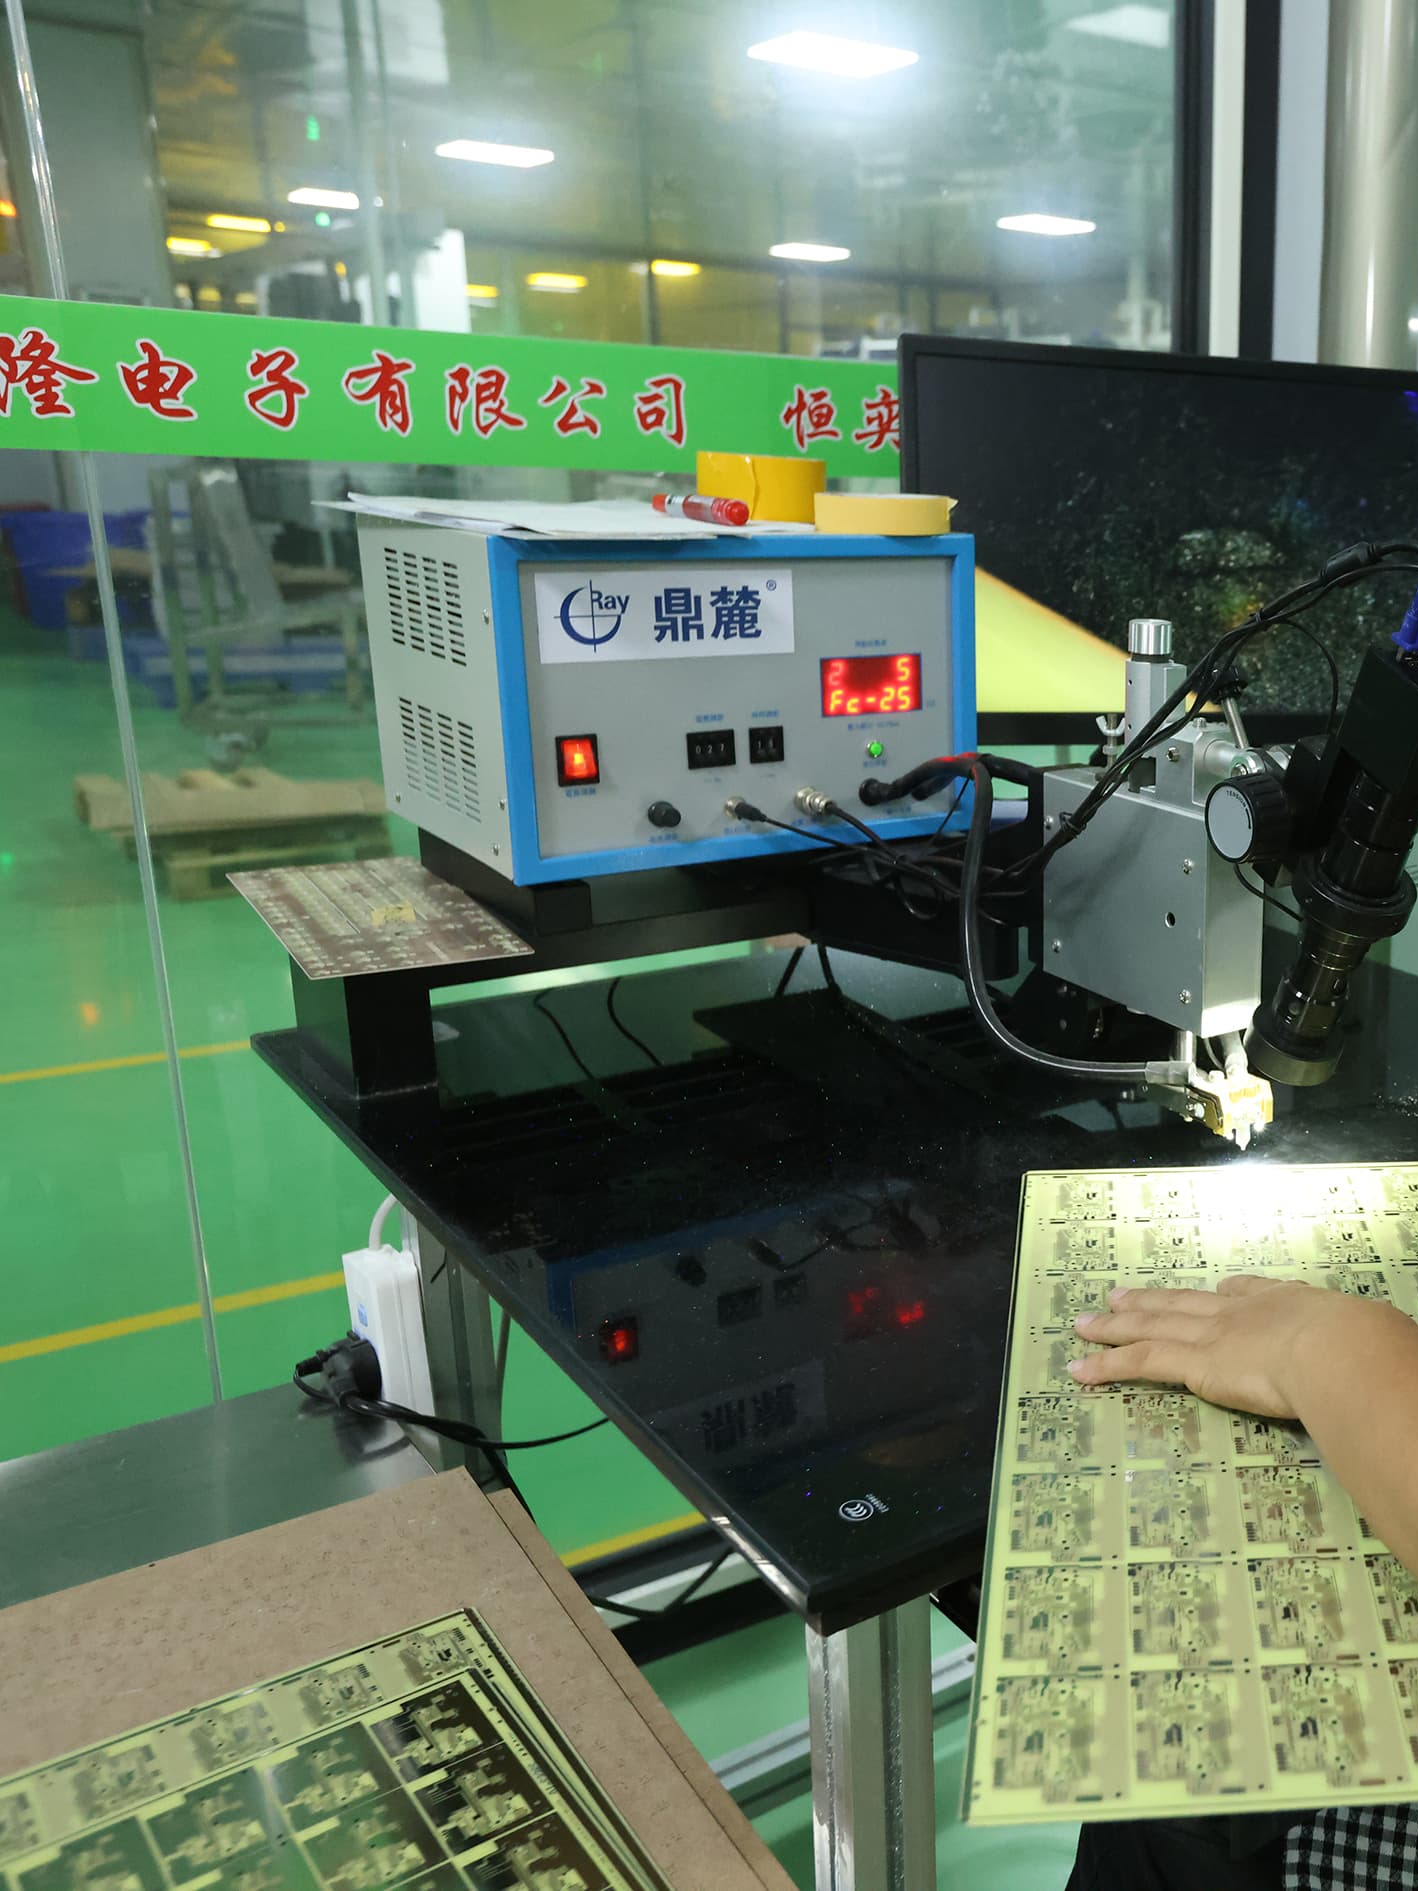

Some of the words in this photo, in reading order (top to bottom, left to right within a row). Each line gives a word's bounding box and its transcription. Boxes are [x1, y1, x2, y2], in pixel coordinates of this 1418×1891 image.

[0, 327, 688, 448] 隆电子有限公司
[653, 585, 762, 643] 鼎麓
[896, 657, 911, 682] 5
